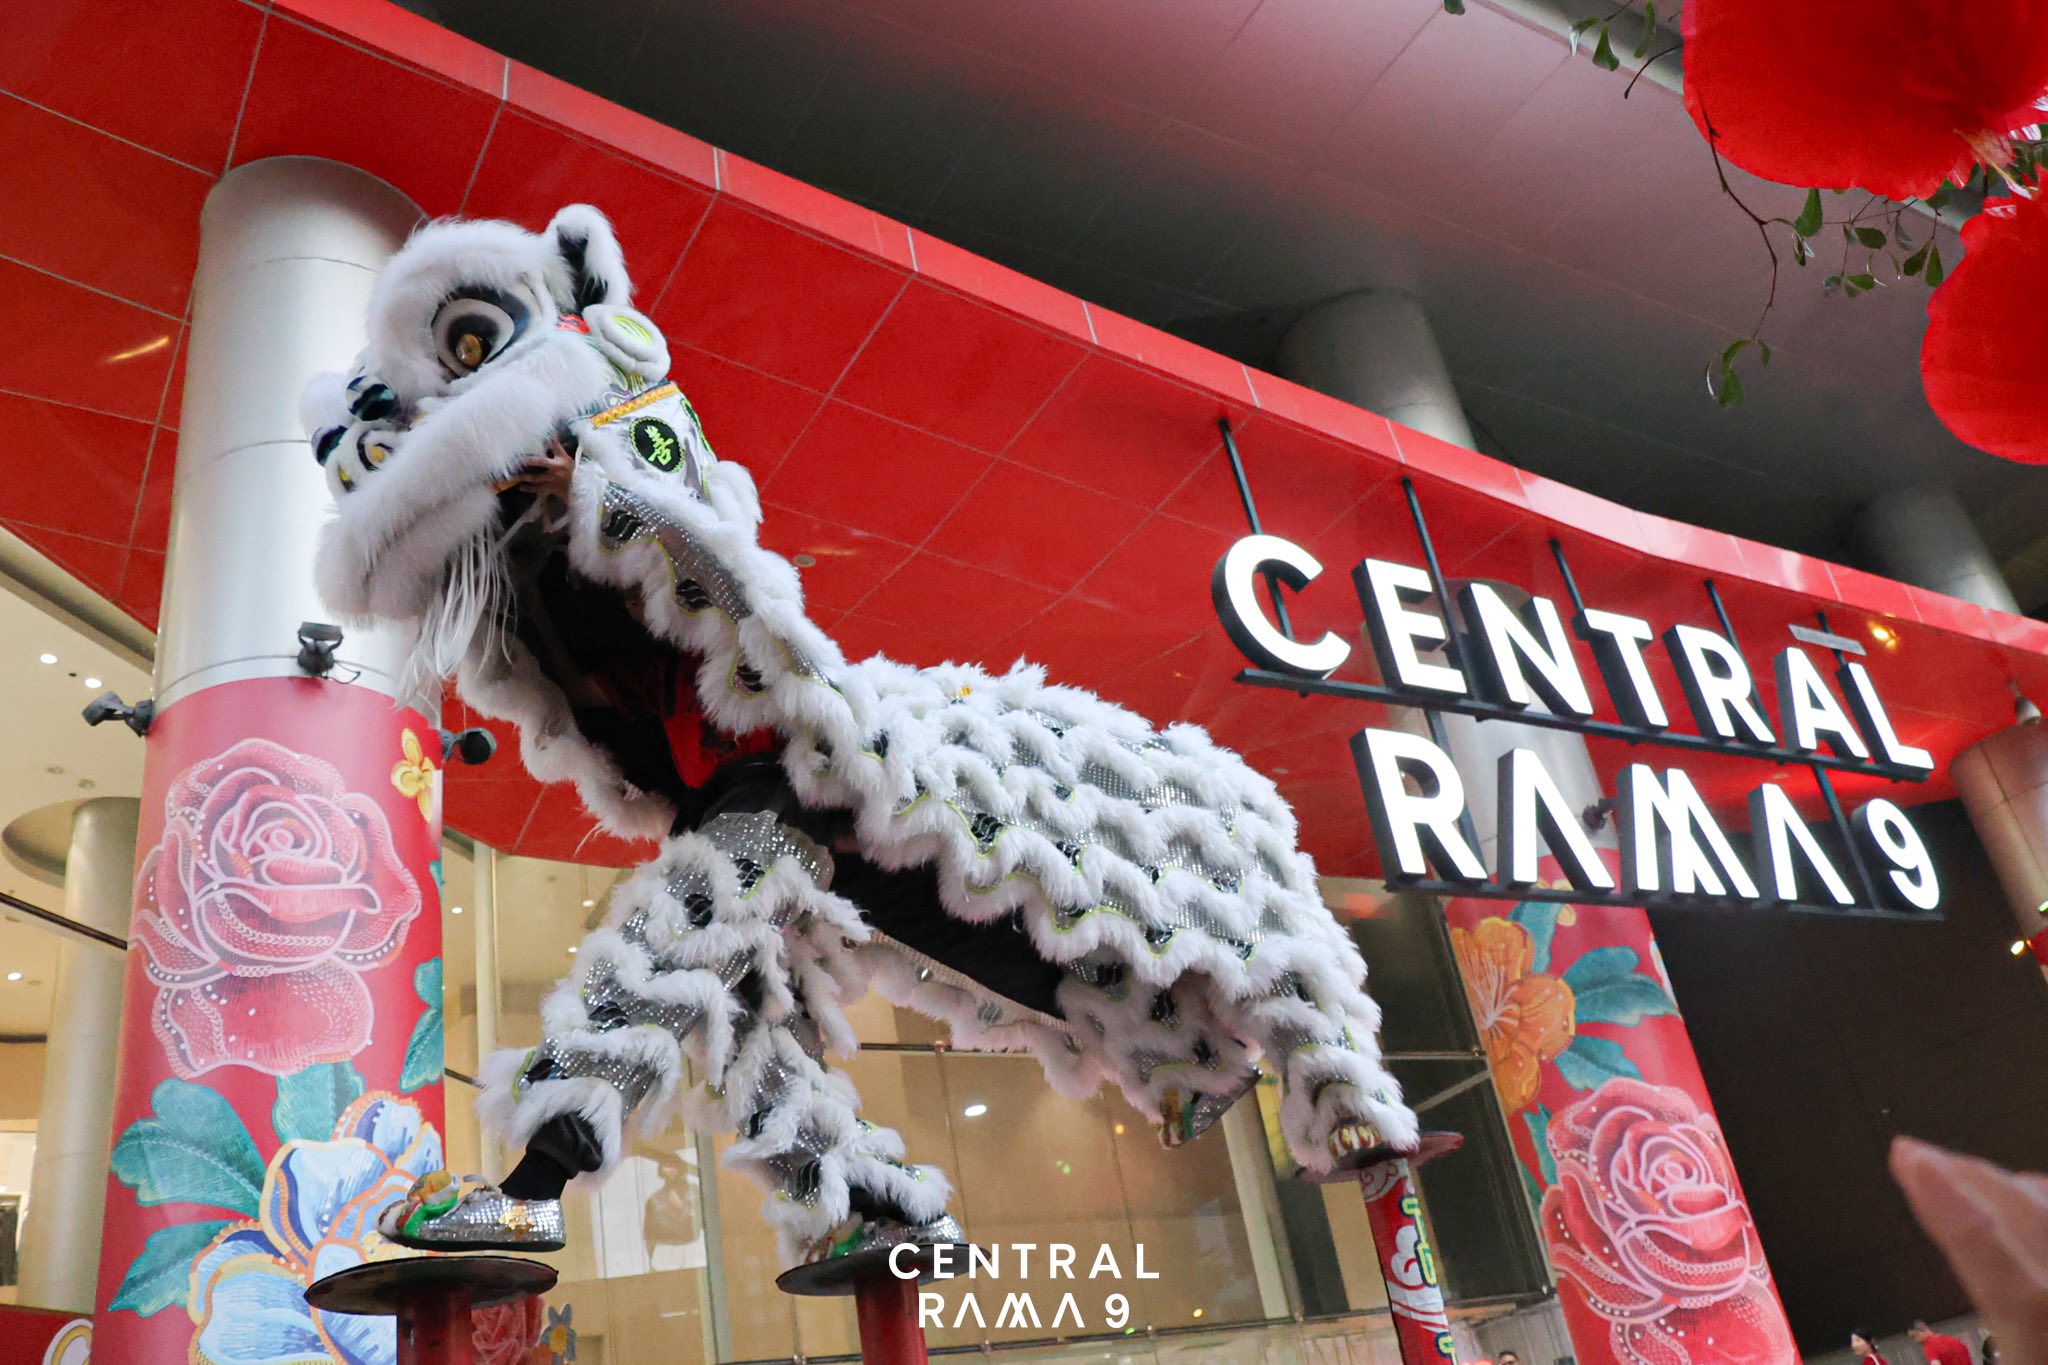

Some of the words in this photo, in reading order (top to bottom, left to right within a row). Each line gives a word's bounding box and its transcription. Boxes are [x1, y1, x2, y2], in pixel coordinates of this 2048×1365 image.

[1222, 534, 1934, 770] CENTRAL
[1361, 727, 1856, 905] RAMA
[1863, 798, 1941, 911] 9
